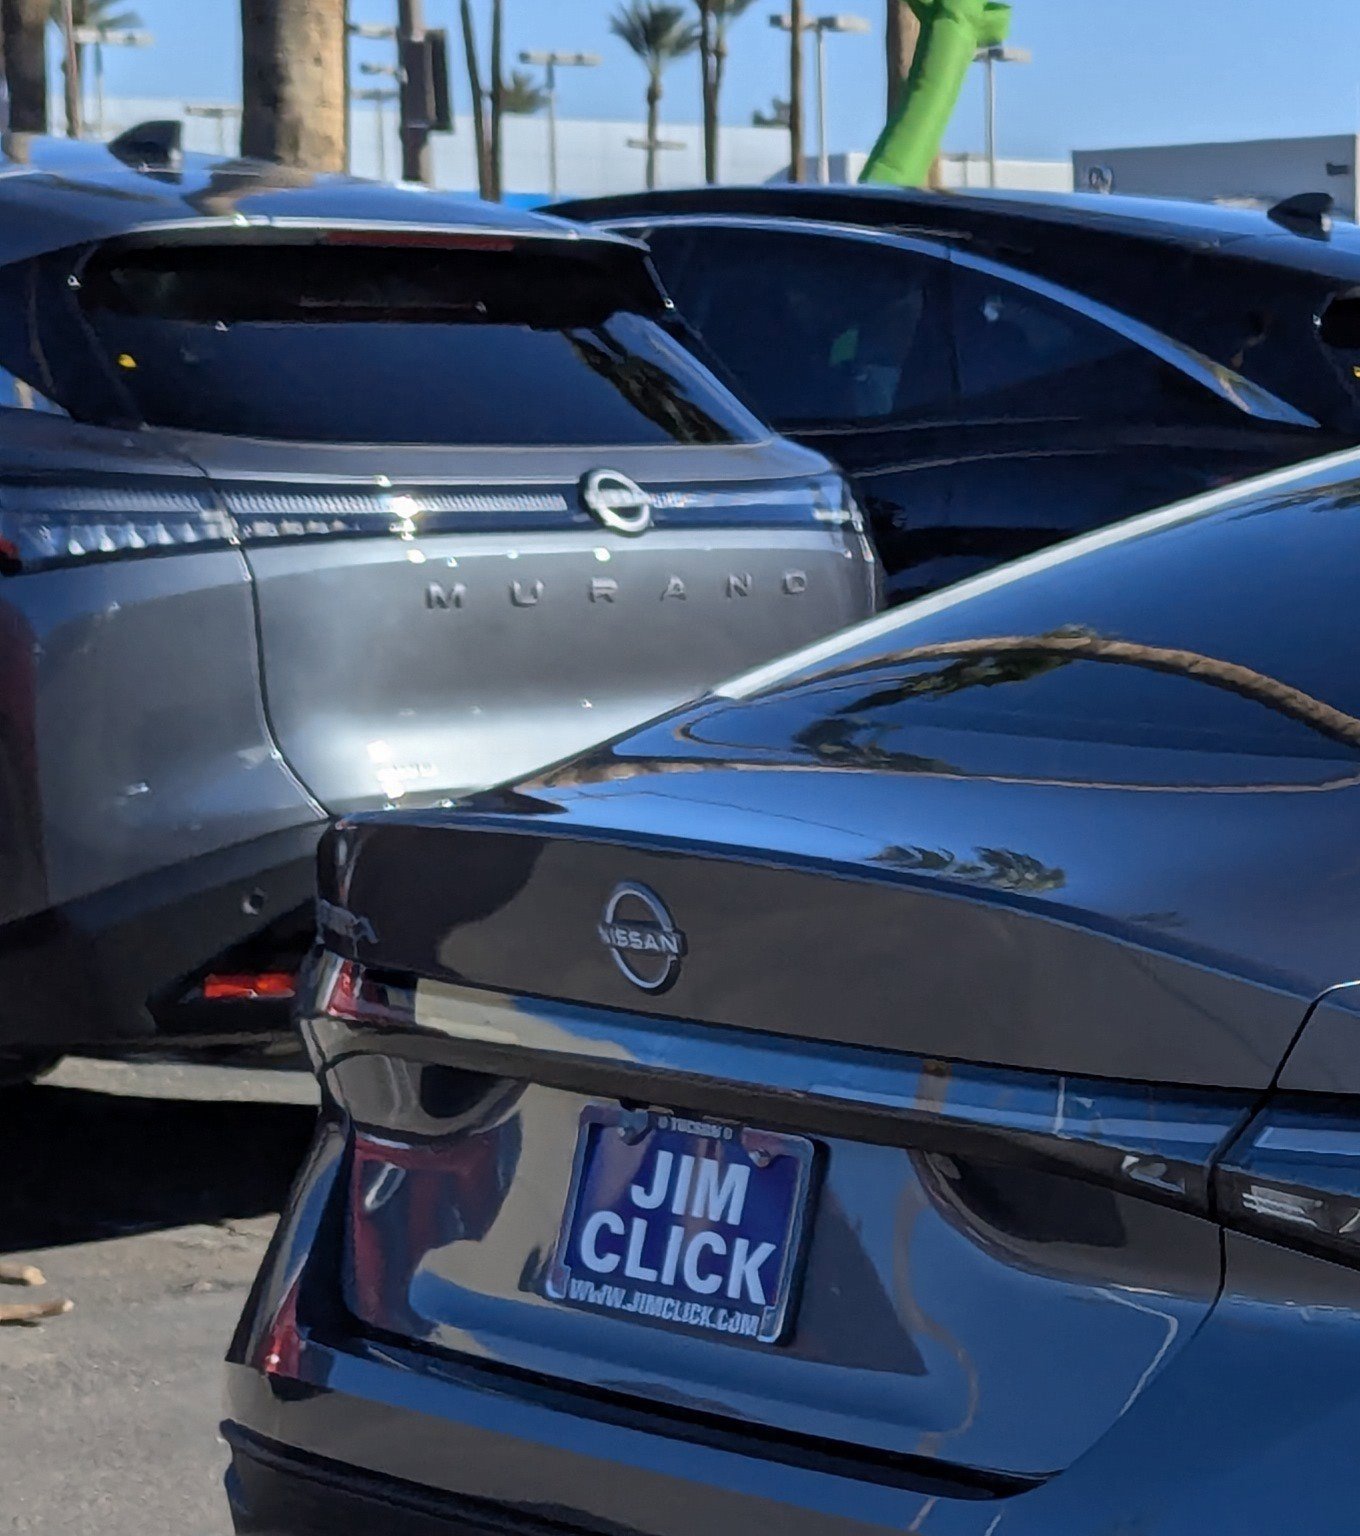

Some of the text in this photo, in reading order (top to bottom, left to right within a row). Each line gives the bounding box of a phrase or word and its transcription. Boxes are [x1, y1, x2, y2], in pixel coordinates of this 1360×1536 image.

[425, 569, 808, 610] MURANO
[598, 924, 679, 954] NISSAN
[630, 1149, 751, 1226] JIM
[580, 1210, 777, 1306] CLICK
